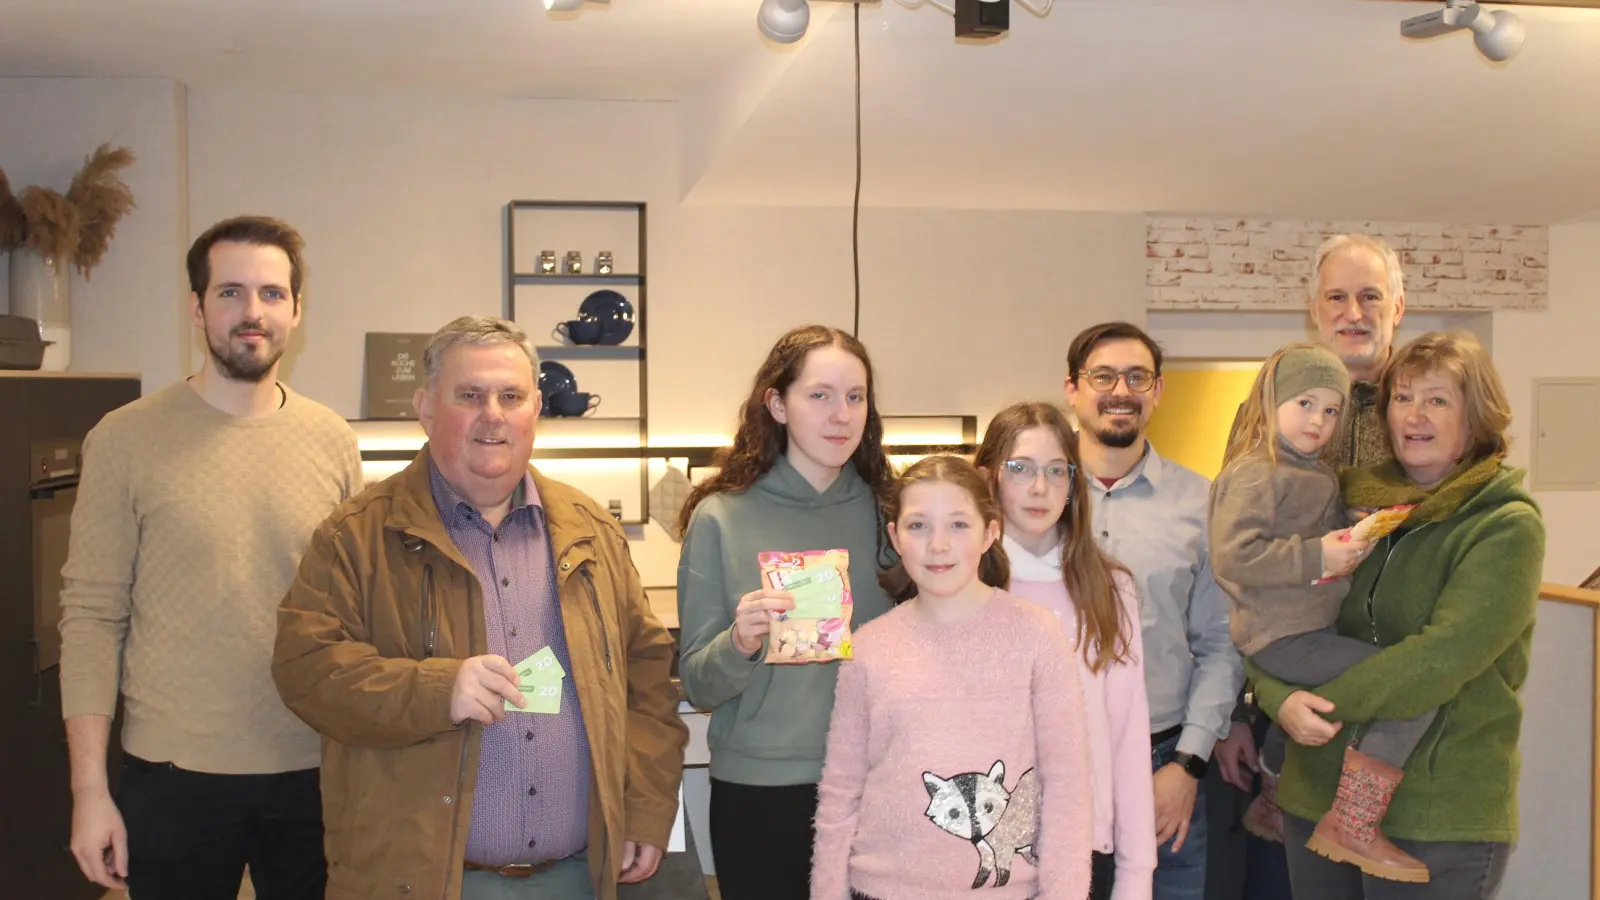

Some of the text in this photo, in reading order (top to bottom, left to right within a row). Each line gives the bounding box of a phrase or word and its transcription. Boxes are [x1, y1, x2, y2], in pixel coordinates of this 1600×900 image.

[816, 569, 834, 583] 20
[535, 656, 553, 671] 20
[539, 686, 558, 698] 20
